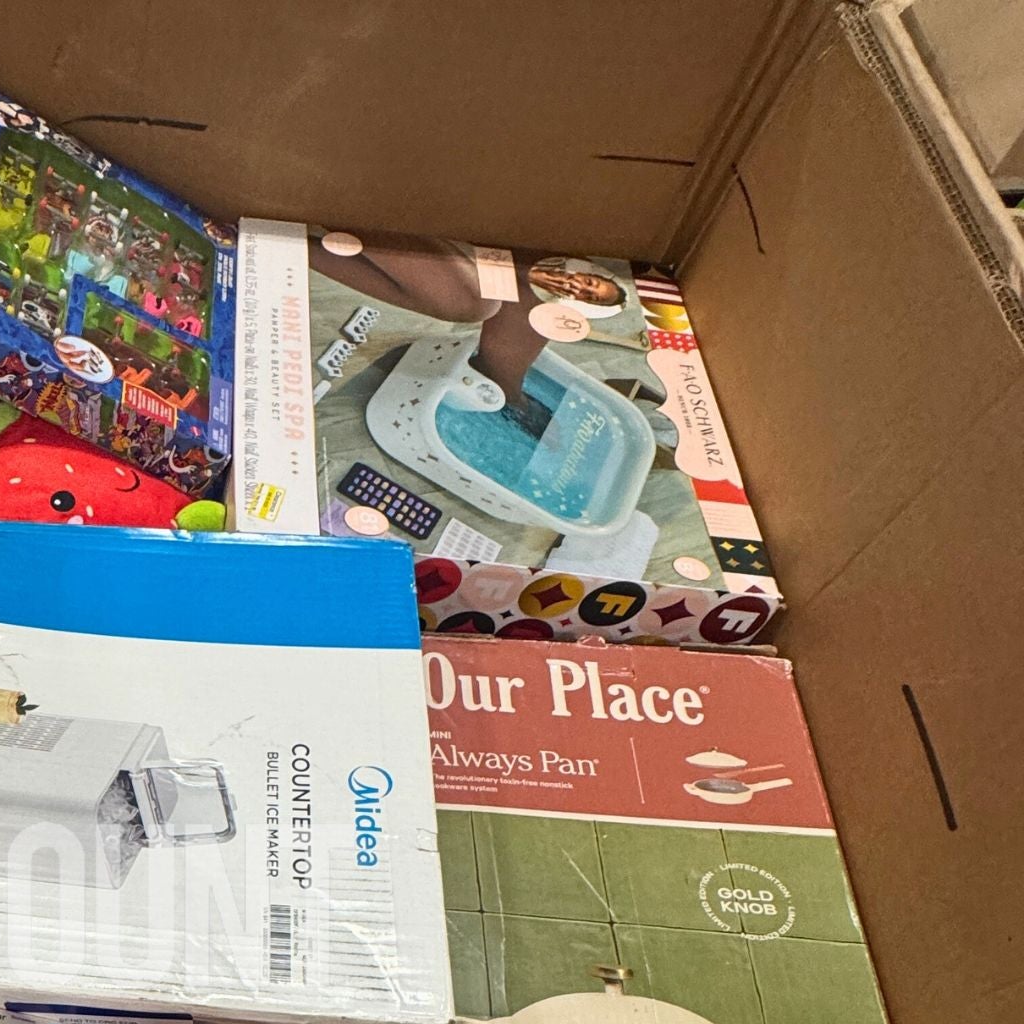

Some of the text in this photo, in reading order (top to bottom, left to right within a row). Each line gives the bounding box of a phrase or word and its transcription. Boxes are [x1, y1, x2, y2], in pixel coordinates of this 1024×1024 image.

[270, 308, 278, 344] PAMPER
[271, 359, 279, 396] BEAUTY
[281, 295, 304, 440] MANI PEDI SPA
[271, 401, 280, 421] SET
[690, 396, 724, 468] SCHWARZ
[720, 609, 759, 633] F
[422, 650, 525, 714] Our
[431, 744, 533, 776] Always
[434, 784, 498, 793] ookware system
[447, 774, 574, 789] revolutionary toxin-free nonstick
[267, 751, 279, 878] BULLET ICE MAKER
[291, 742, 312, 890] COUNTERTOP
[348, 765, 394, 868] Midea
[717, 887, 774, 902] GOLD
[719, 862, 791, 898] LIMITED EDITION
[720, 901, 778, 915] KNOB
